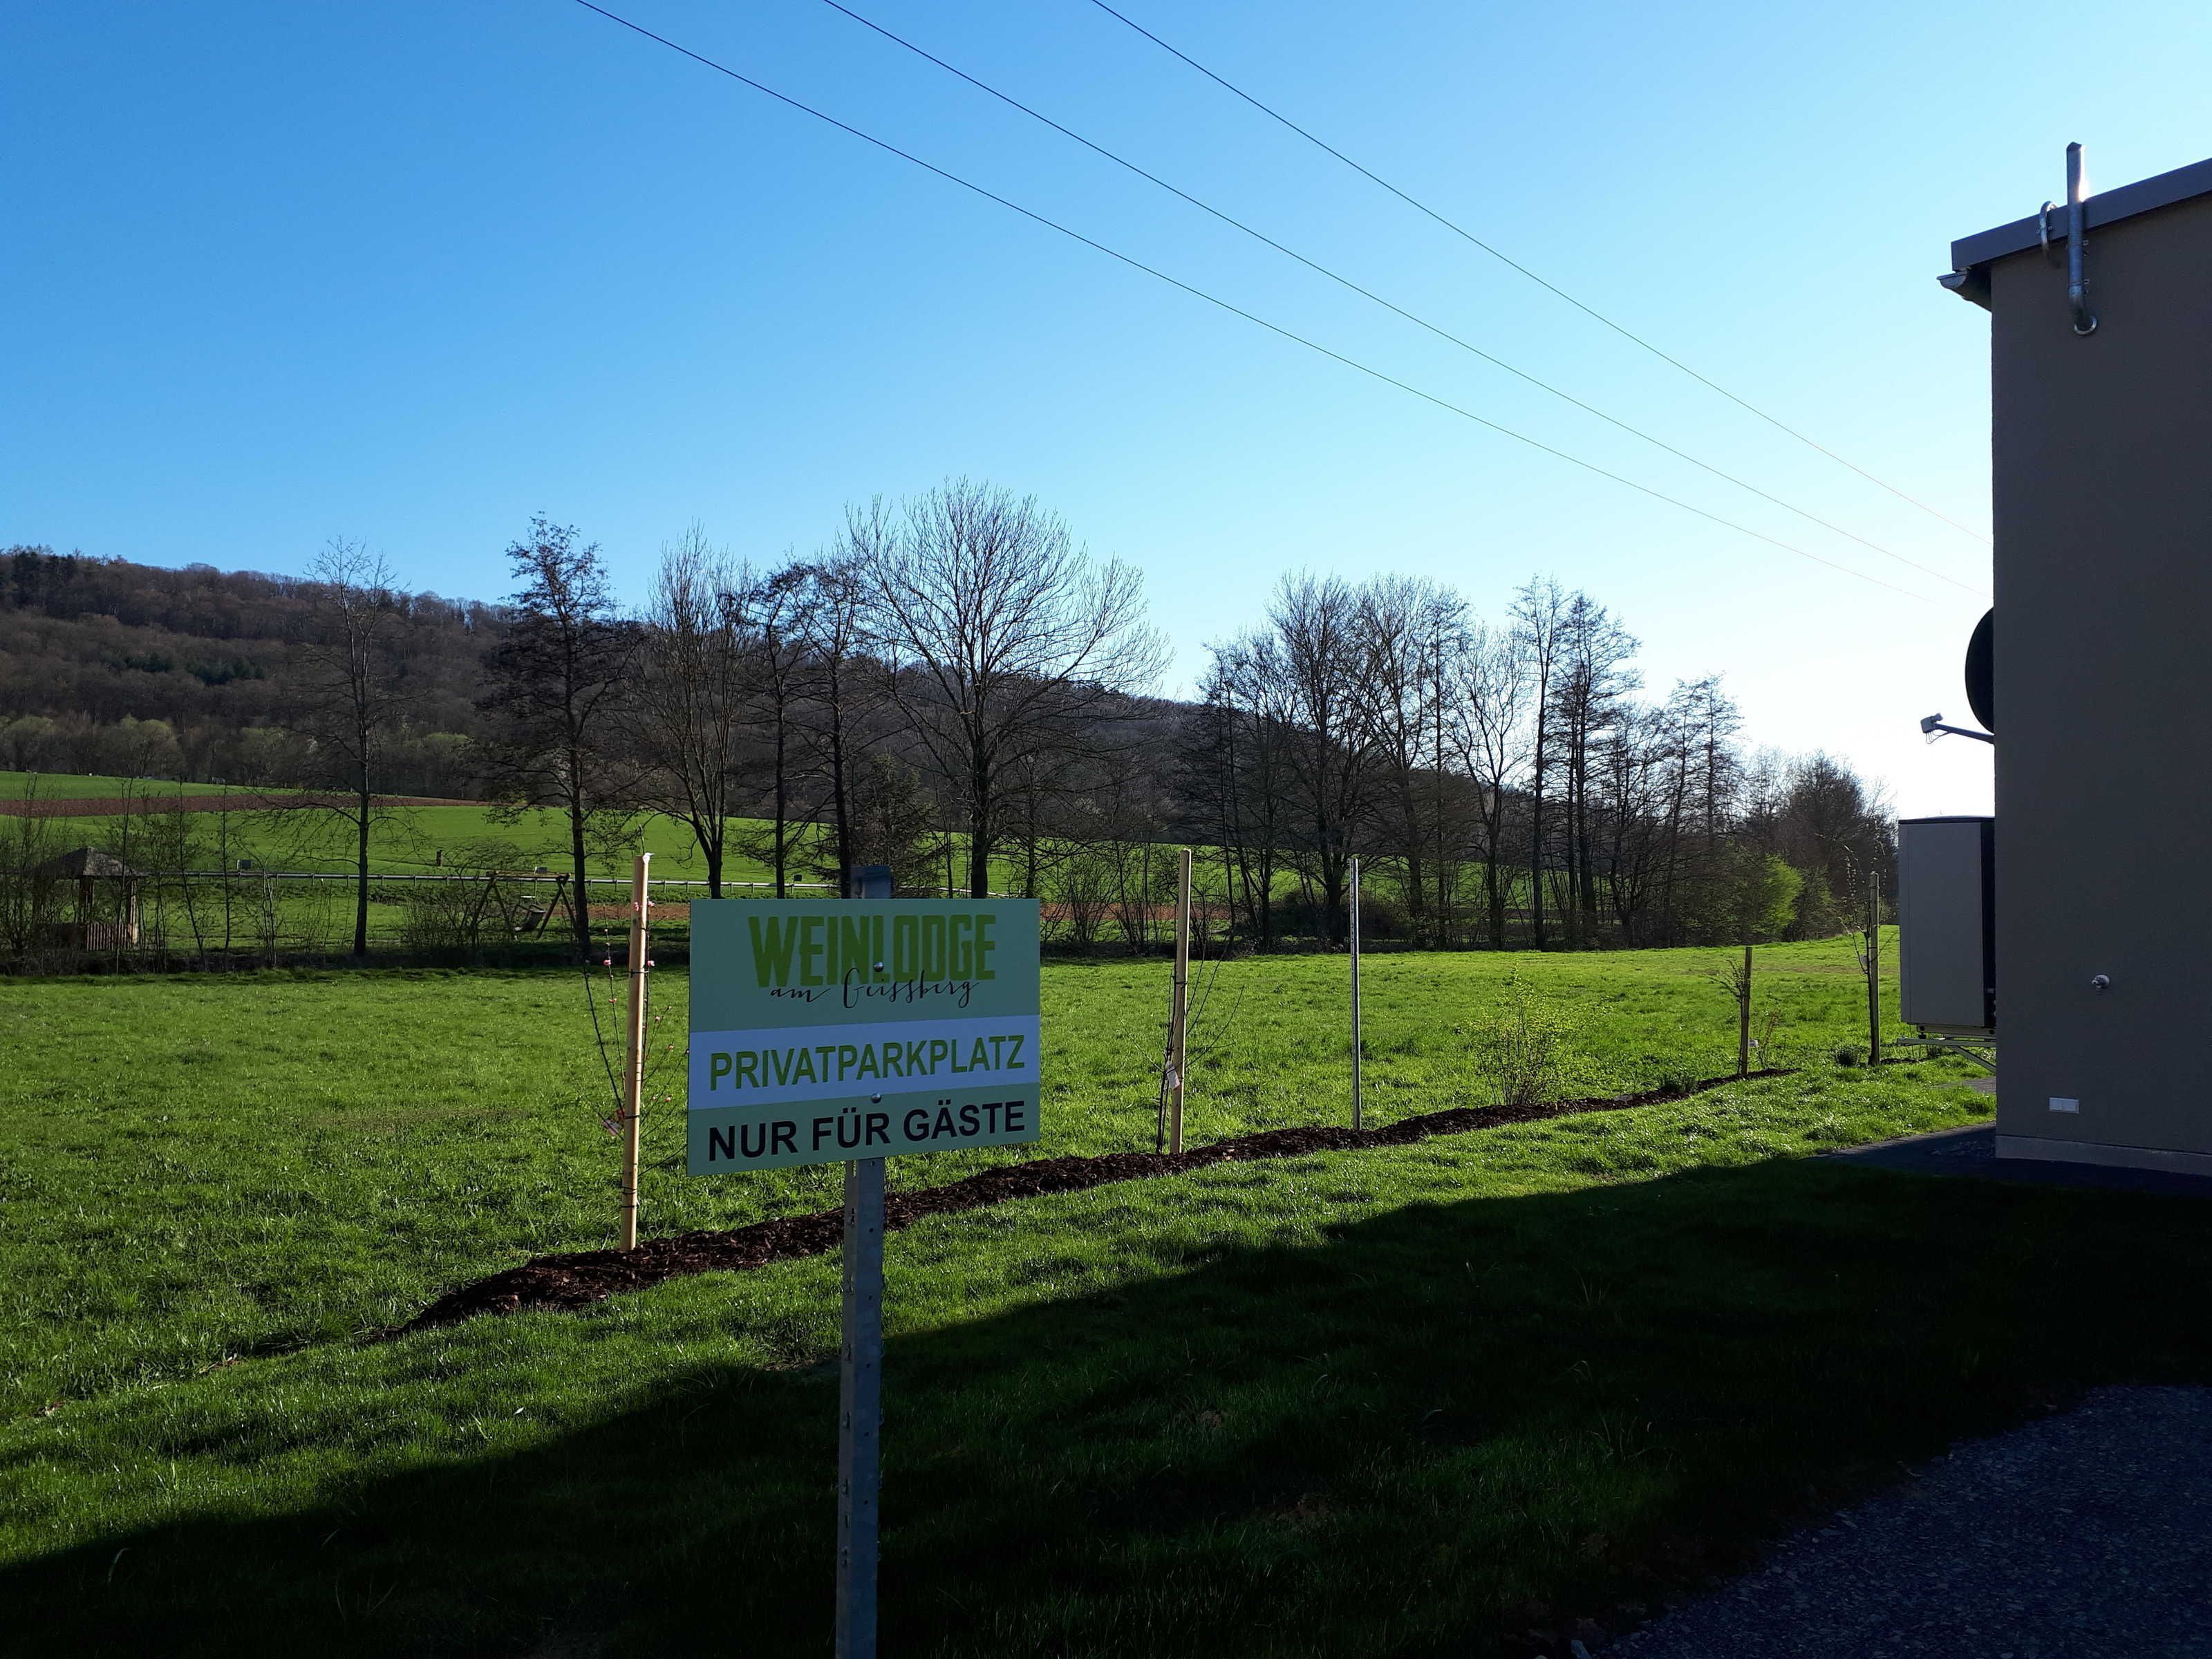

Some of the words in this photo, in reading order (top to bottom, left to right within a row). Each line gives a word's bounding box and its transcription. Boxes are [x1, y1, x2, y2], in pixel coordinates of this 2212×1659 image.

[748, 915, 996, 988] WEINLODGE
[769, 986, 830, 1003] am
[843, 967, 979, 1008] Geissberg
[710, 1035, 1024, 1090] PRIVATPARKPLATZ
[709, 1121, 797, 1161] NUR
[812, 1107, 890, 1151] FÜR
[903, 1099, 1025, 1141] GÄSTE
